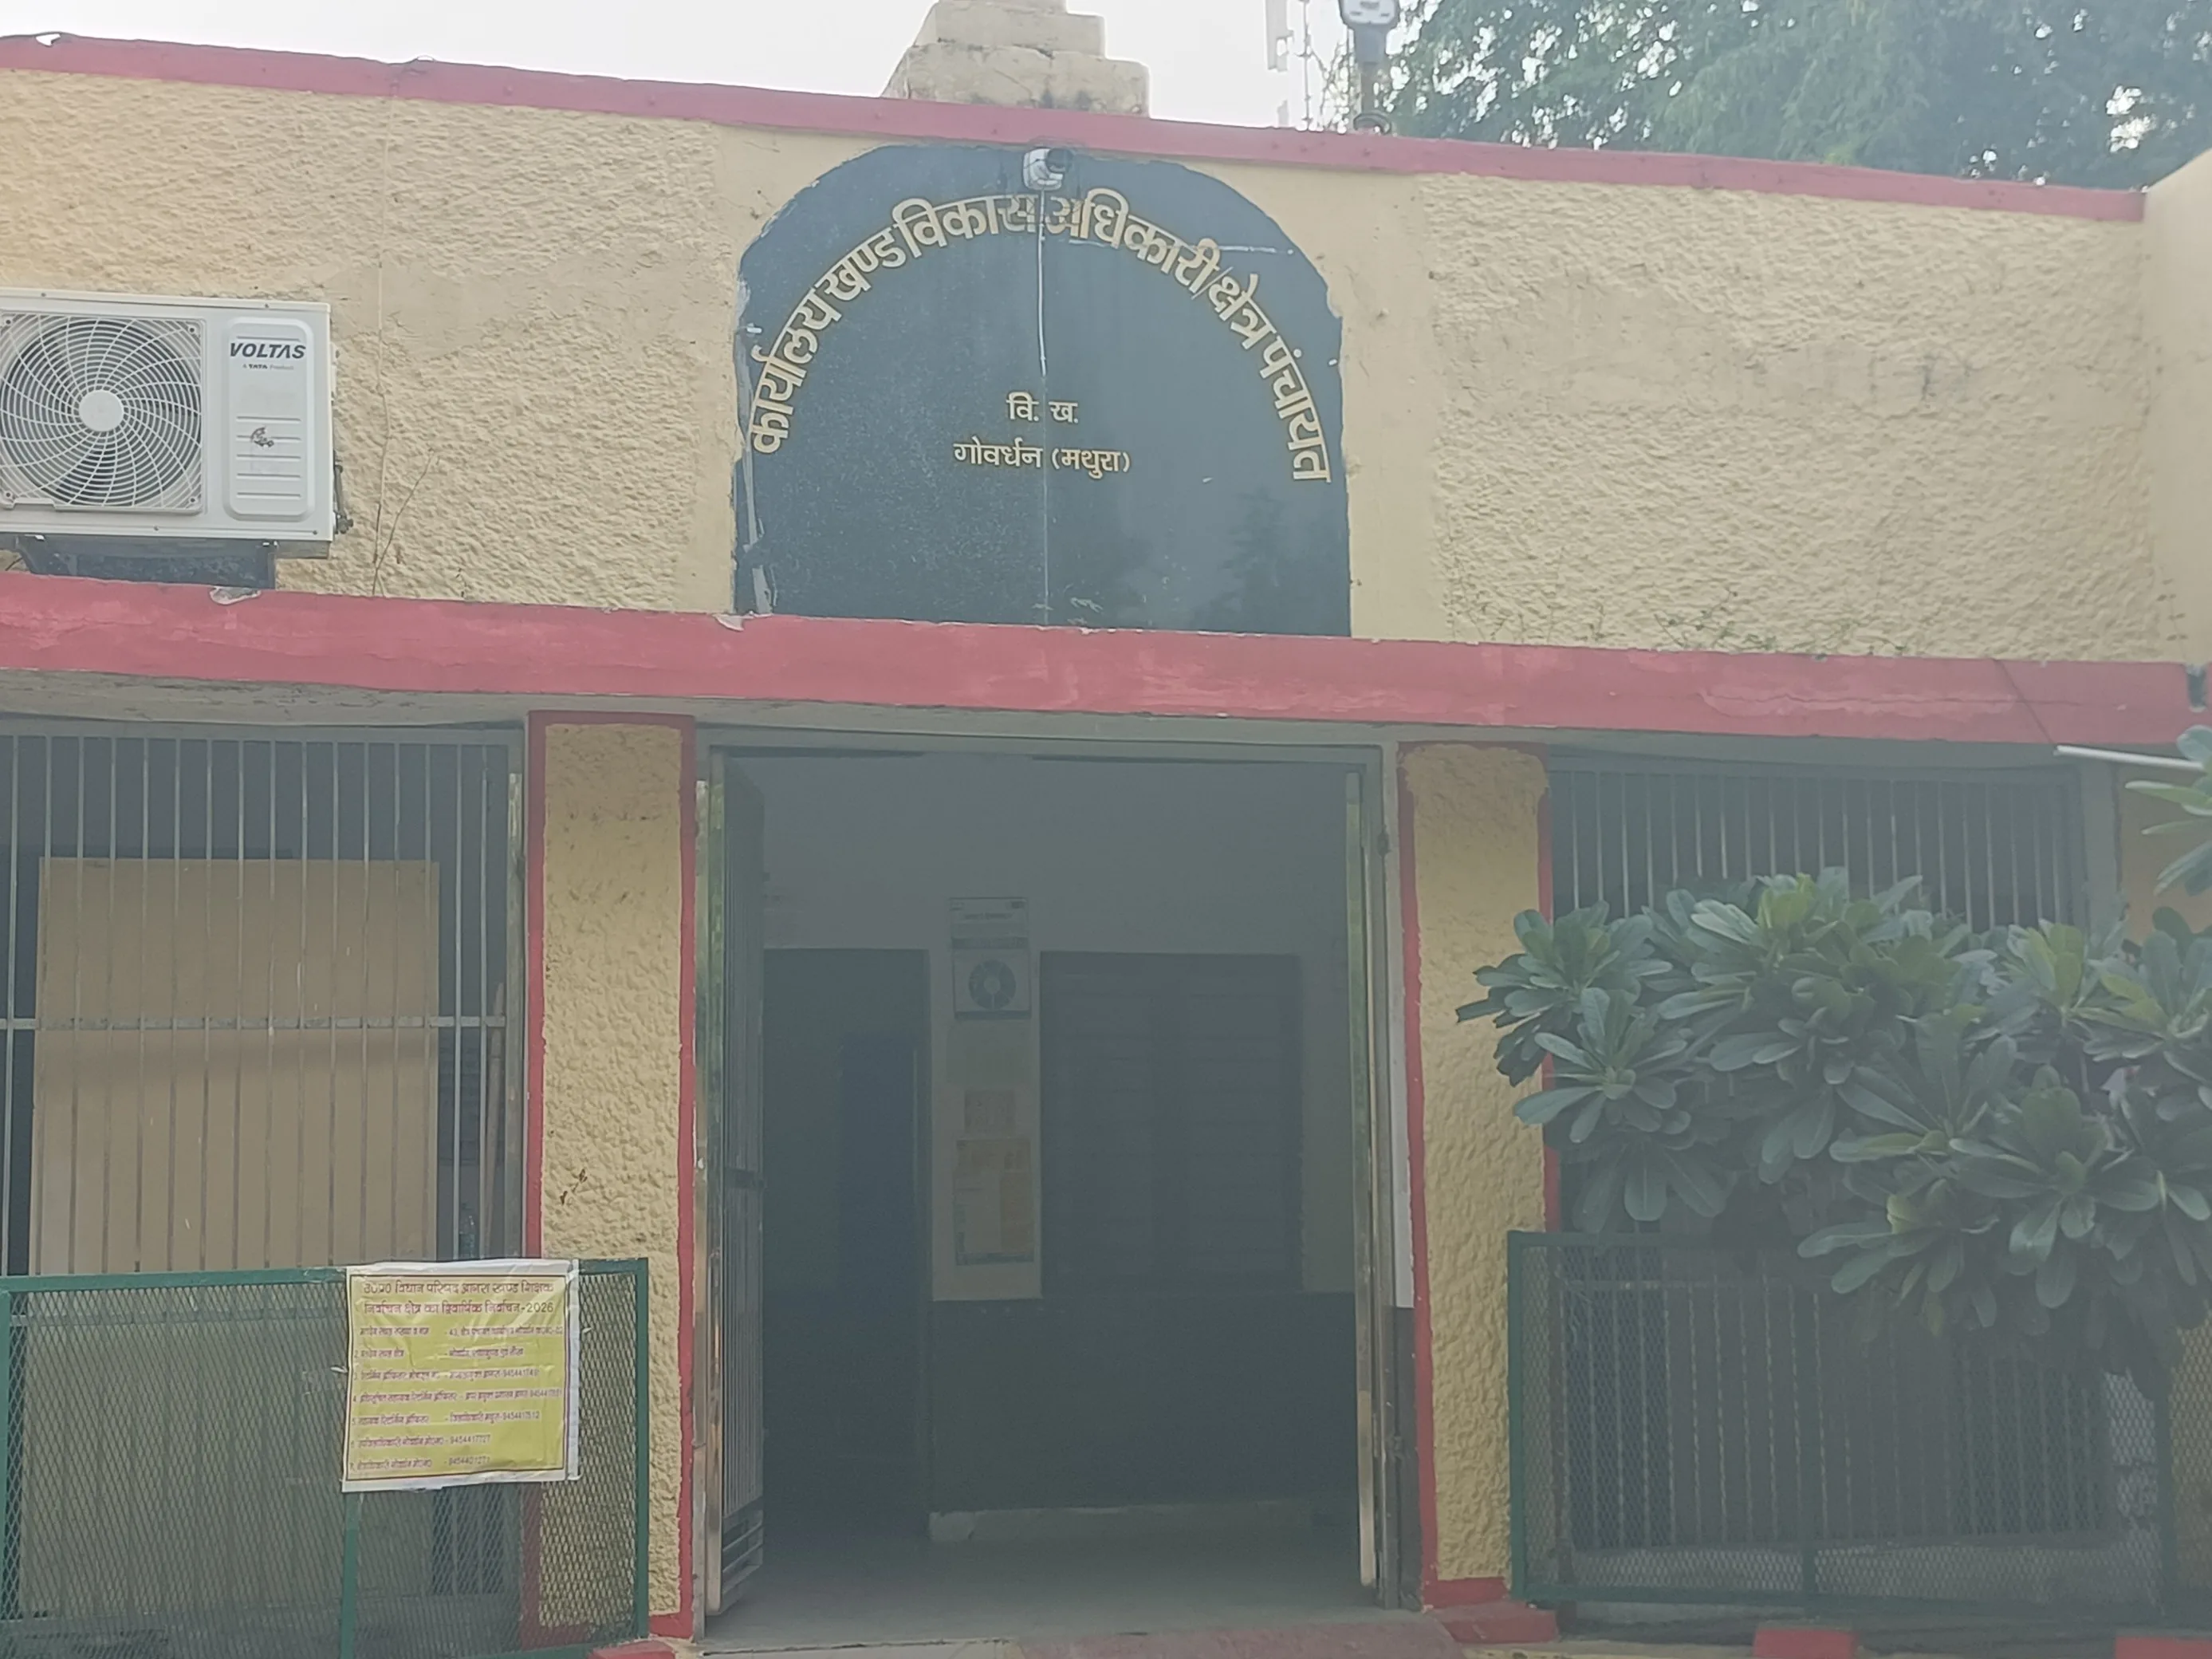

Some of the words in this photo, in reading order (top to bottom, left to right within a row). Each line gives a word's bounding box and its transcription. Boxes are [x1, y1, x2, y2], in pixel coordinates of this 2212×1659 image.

[230, 342, 306, 359] VOLTAS
[750, 287, 841, 455] कार्यालय
[813, 227, 908, 301] खण्ड
[892, 194, 1036, 259] विकास
[1260, 336, 1331, 483] पंचायत
[953, 435, 1043, 468] गोवर्धन
[1050, 448, 1131, 479] (मथुरा)
[492, 1283, 519, 1293] खण्ड
